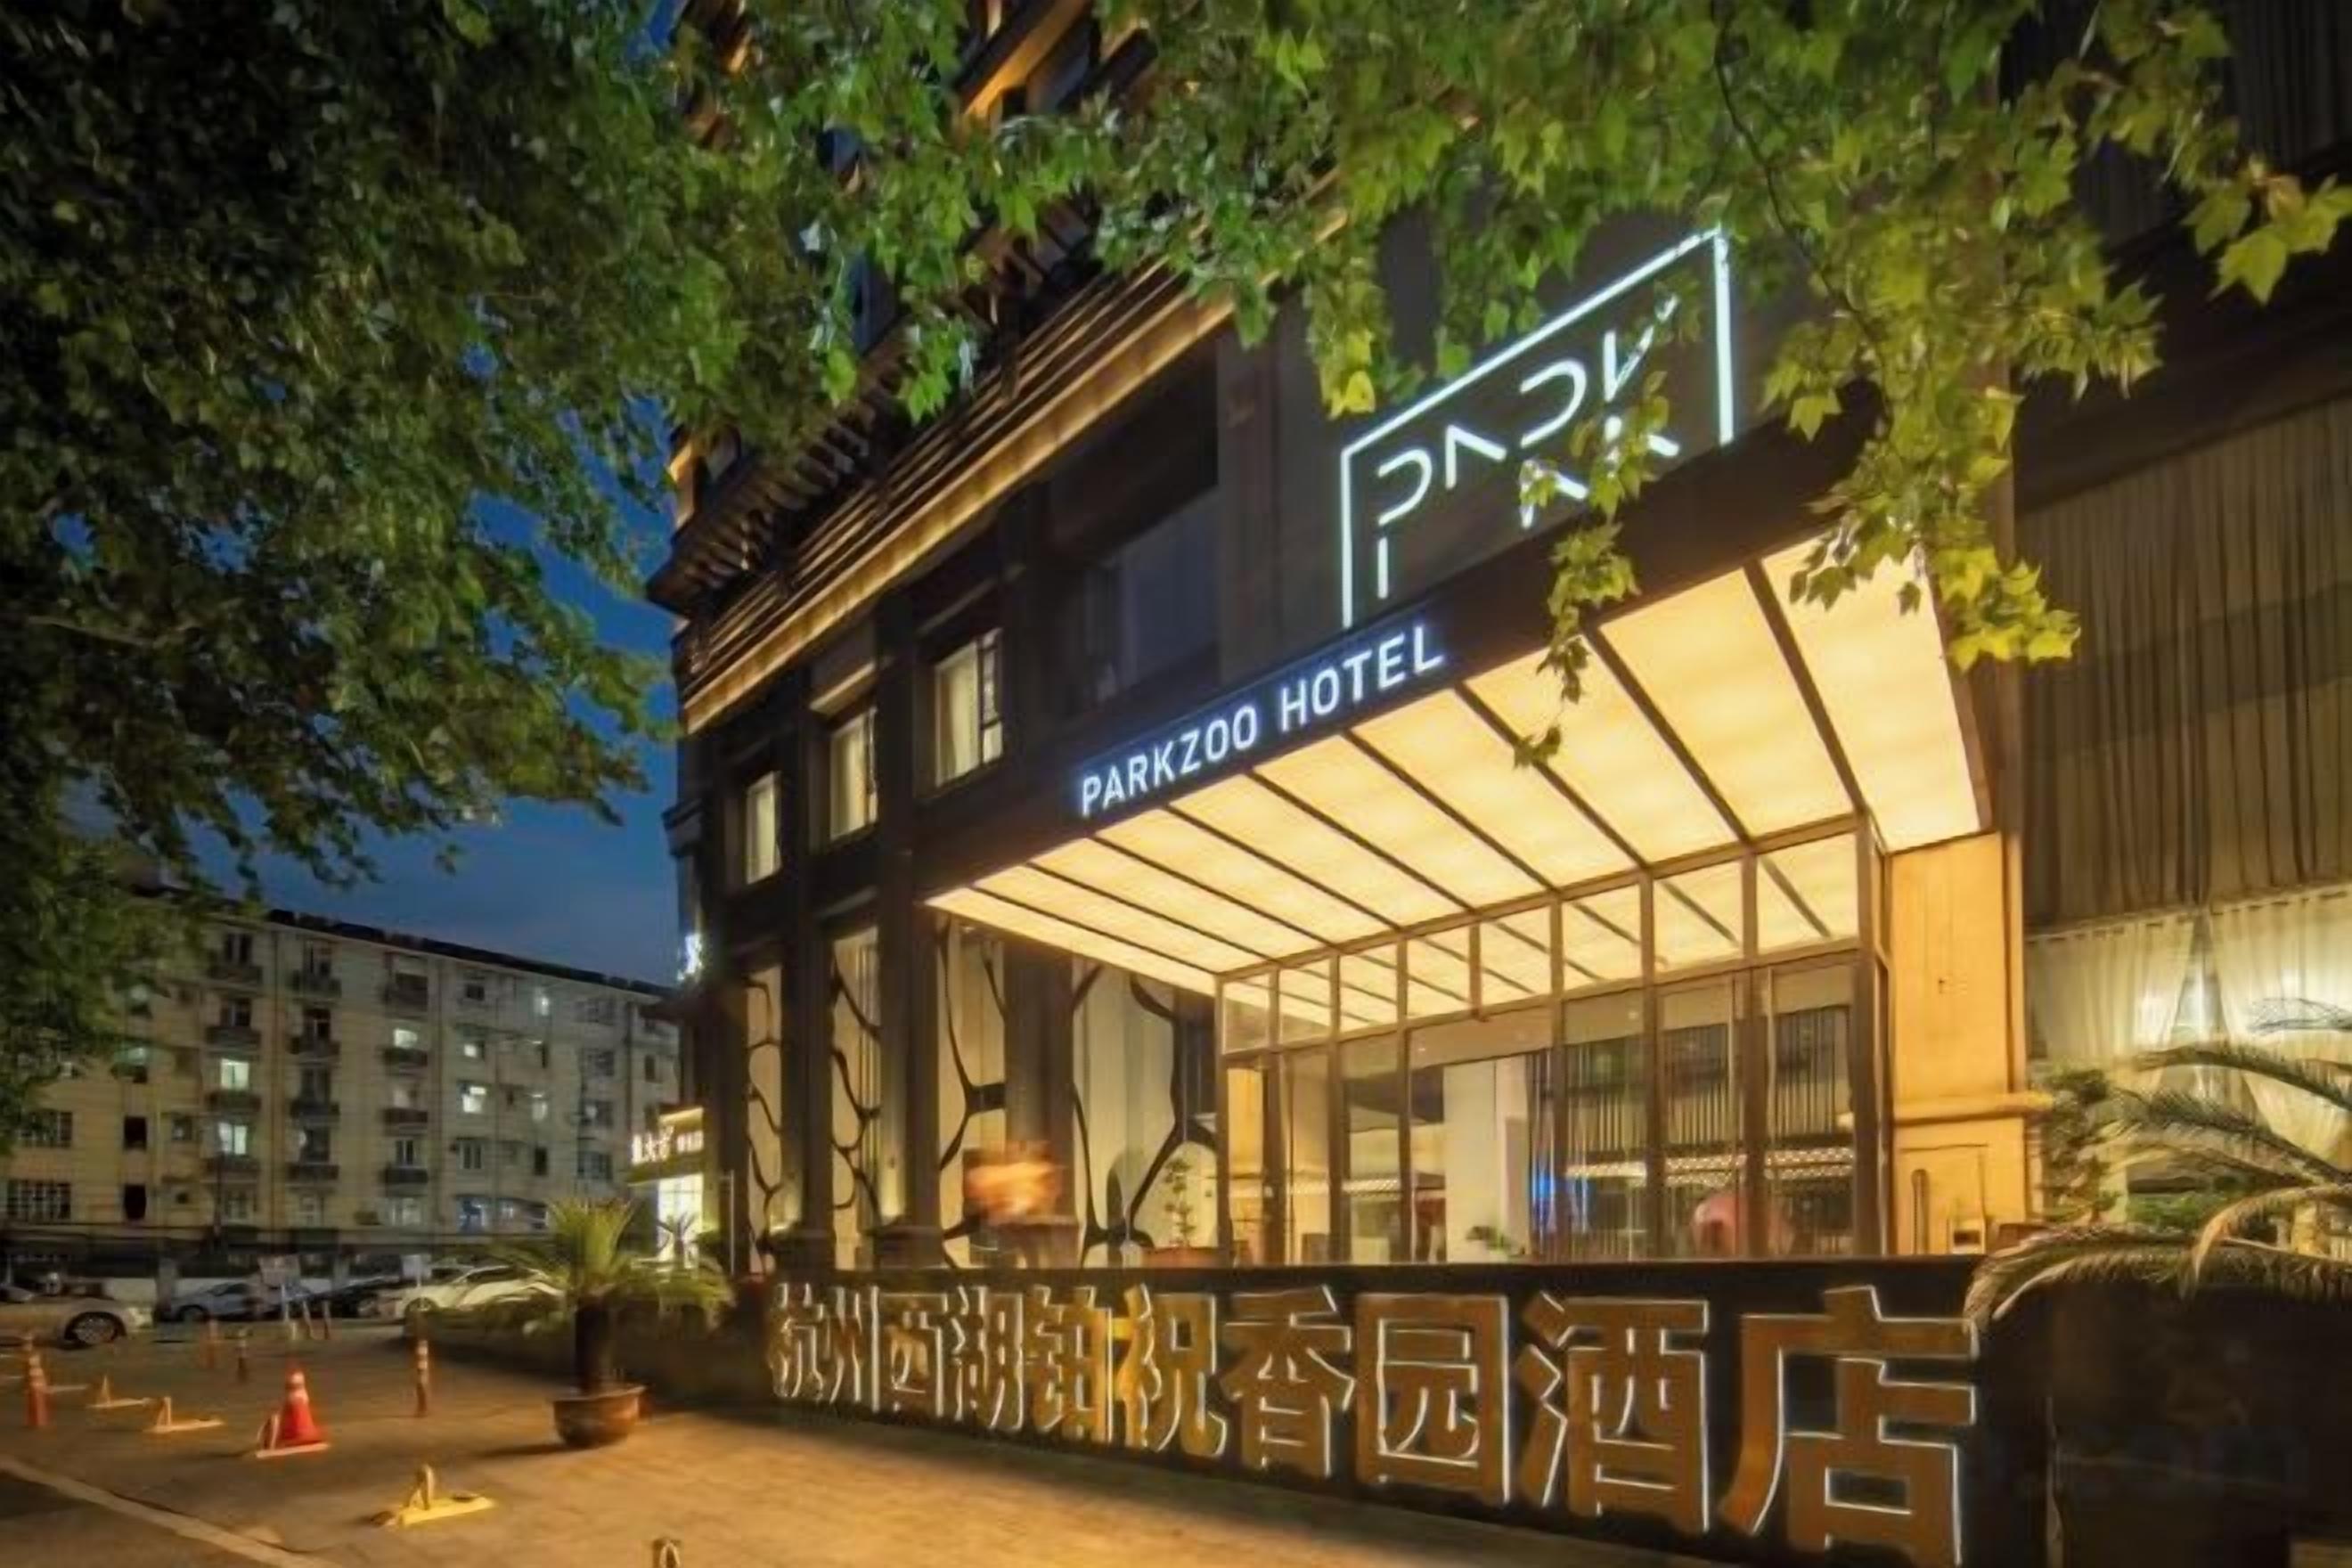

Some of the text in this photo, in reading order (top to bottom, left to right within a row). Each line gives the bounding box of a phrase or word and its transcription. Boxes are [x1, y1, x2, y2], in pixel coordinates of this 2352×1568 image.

[1376, 294, 1680, 600] PARK
[1080, 625, 1444, 819] PARKZOO HOTEL
